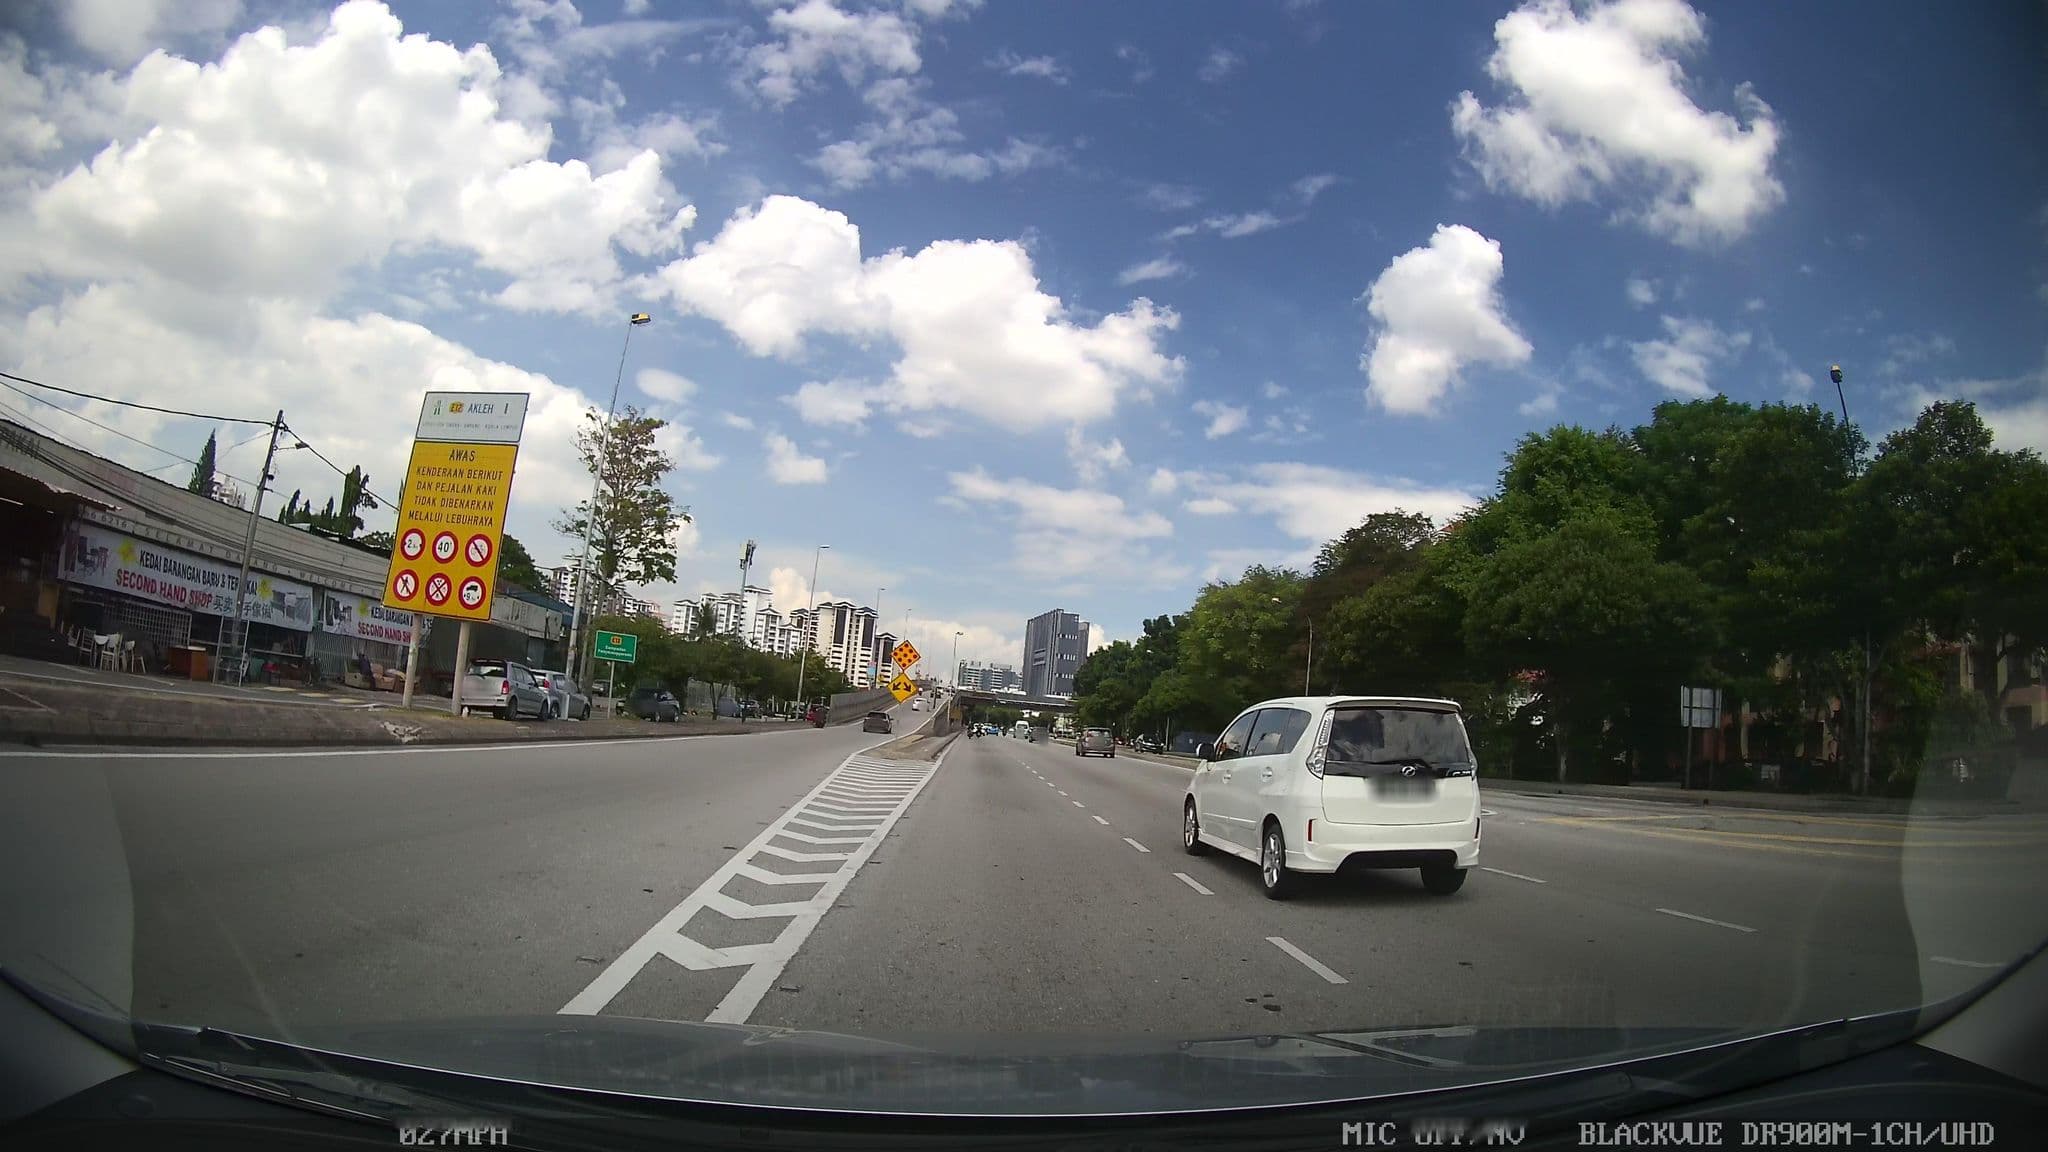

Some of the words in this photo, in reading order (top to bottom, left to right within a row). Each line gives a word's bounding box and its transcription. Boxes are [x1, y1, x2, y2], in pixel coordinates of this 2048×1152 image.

[467, 403, 494, 414] AKLEH
[449, 449, 476, 462] AWAS
[416, 466, 463, 479] KENDERAAN
[467, 469, 503, 481] BERIKUT
[416, 481, 433, 491] DAN
[435, 482, 473, 494] PEJALAN
[476, 485, 497, 496] KAKI
[414, 495, 436, 507] TIDAK
[440, 497, 494, 511] DIBENARKAN
[408, 510, 443, 523] MELALUI
[446, 513, 493, 527] LEBUHRAYA
[139, 550, 162, 572] KEDAI
[163, 558, 201, 584] BARANGAN
[202, 570, 220, 588] BARU
[227, 574, 258, 596] TERKAI
[115, 568, 157, 594] SECOND
[159, 580, 187, 603] HAND
[190, 590, 213, 609] SHOP
[357, 621, 384, 638] SECOND
[384, 626, 402, 641] HAND
